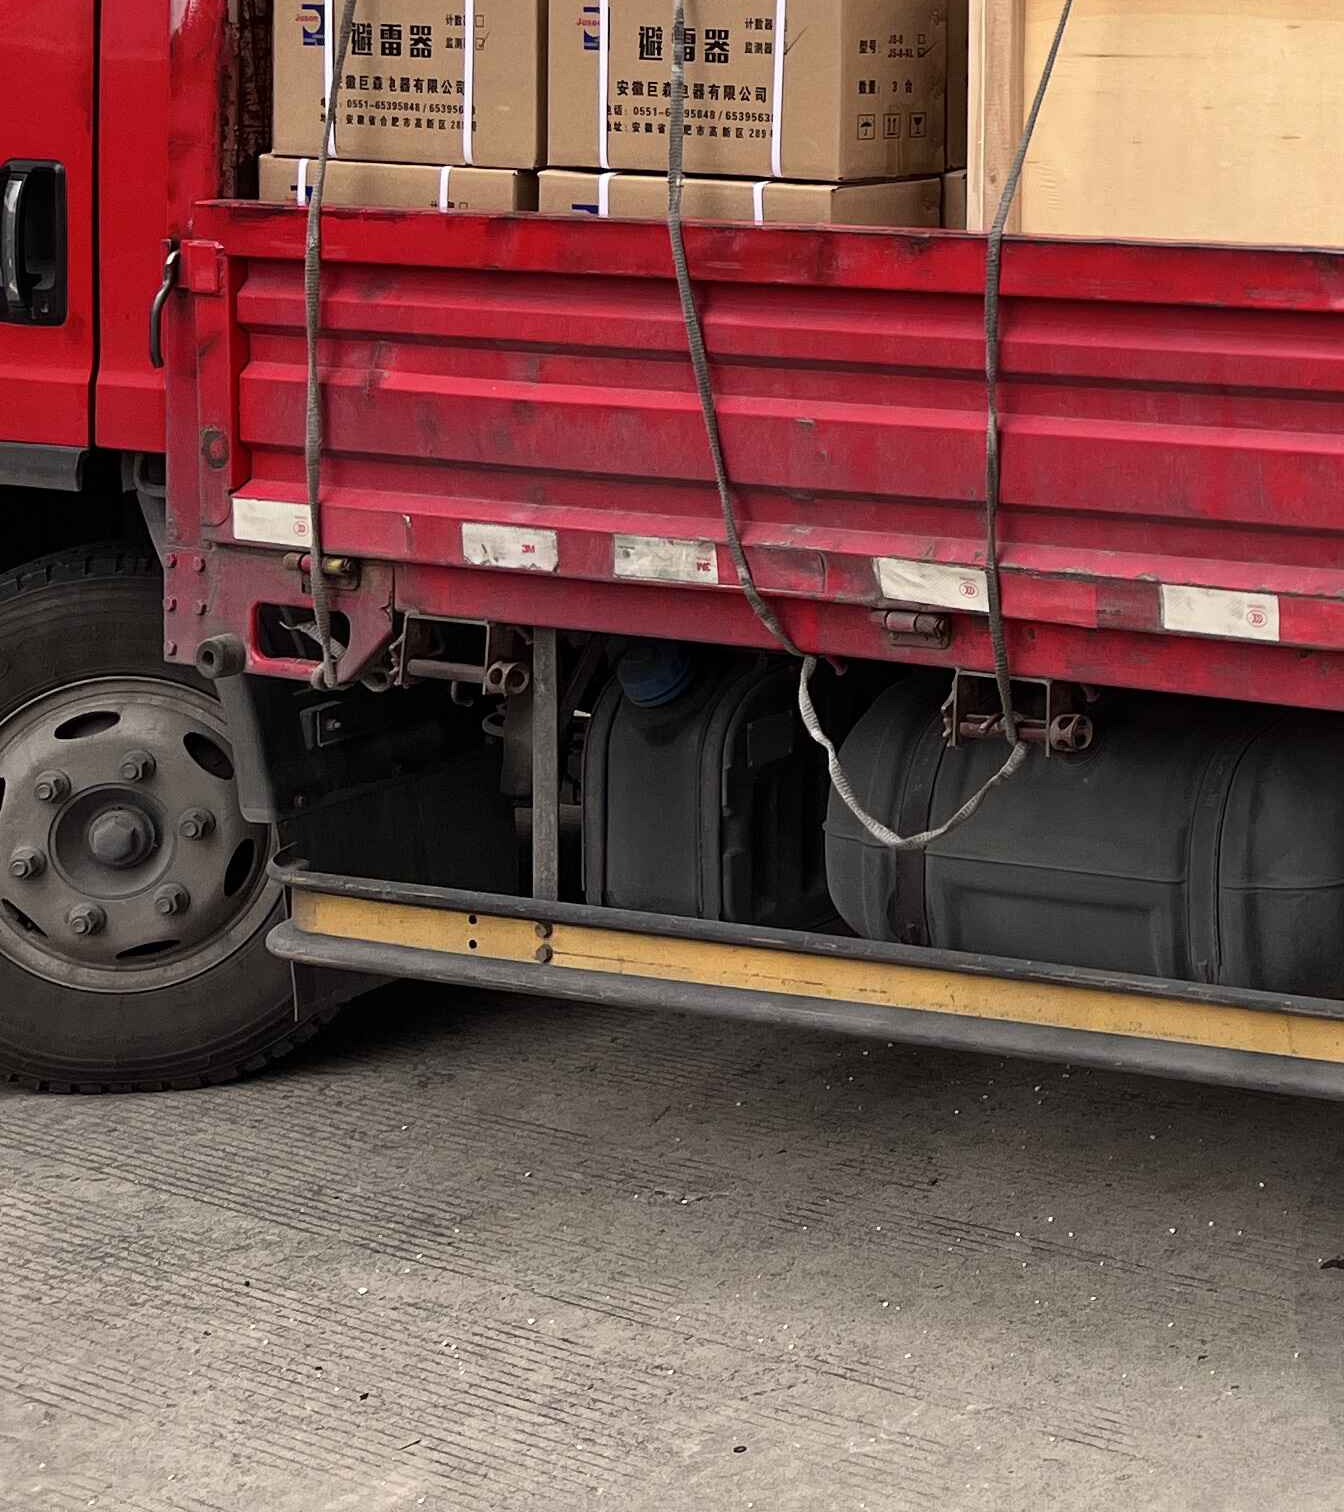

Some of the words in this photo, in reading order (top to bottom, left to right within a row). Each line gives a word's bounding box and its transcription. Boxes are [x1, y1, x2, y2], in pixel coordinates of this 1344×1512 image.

[351, 22, 432, 58] 避雷器
[339, 74, 465, 96] 徽巨森电器有限公司
